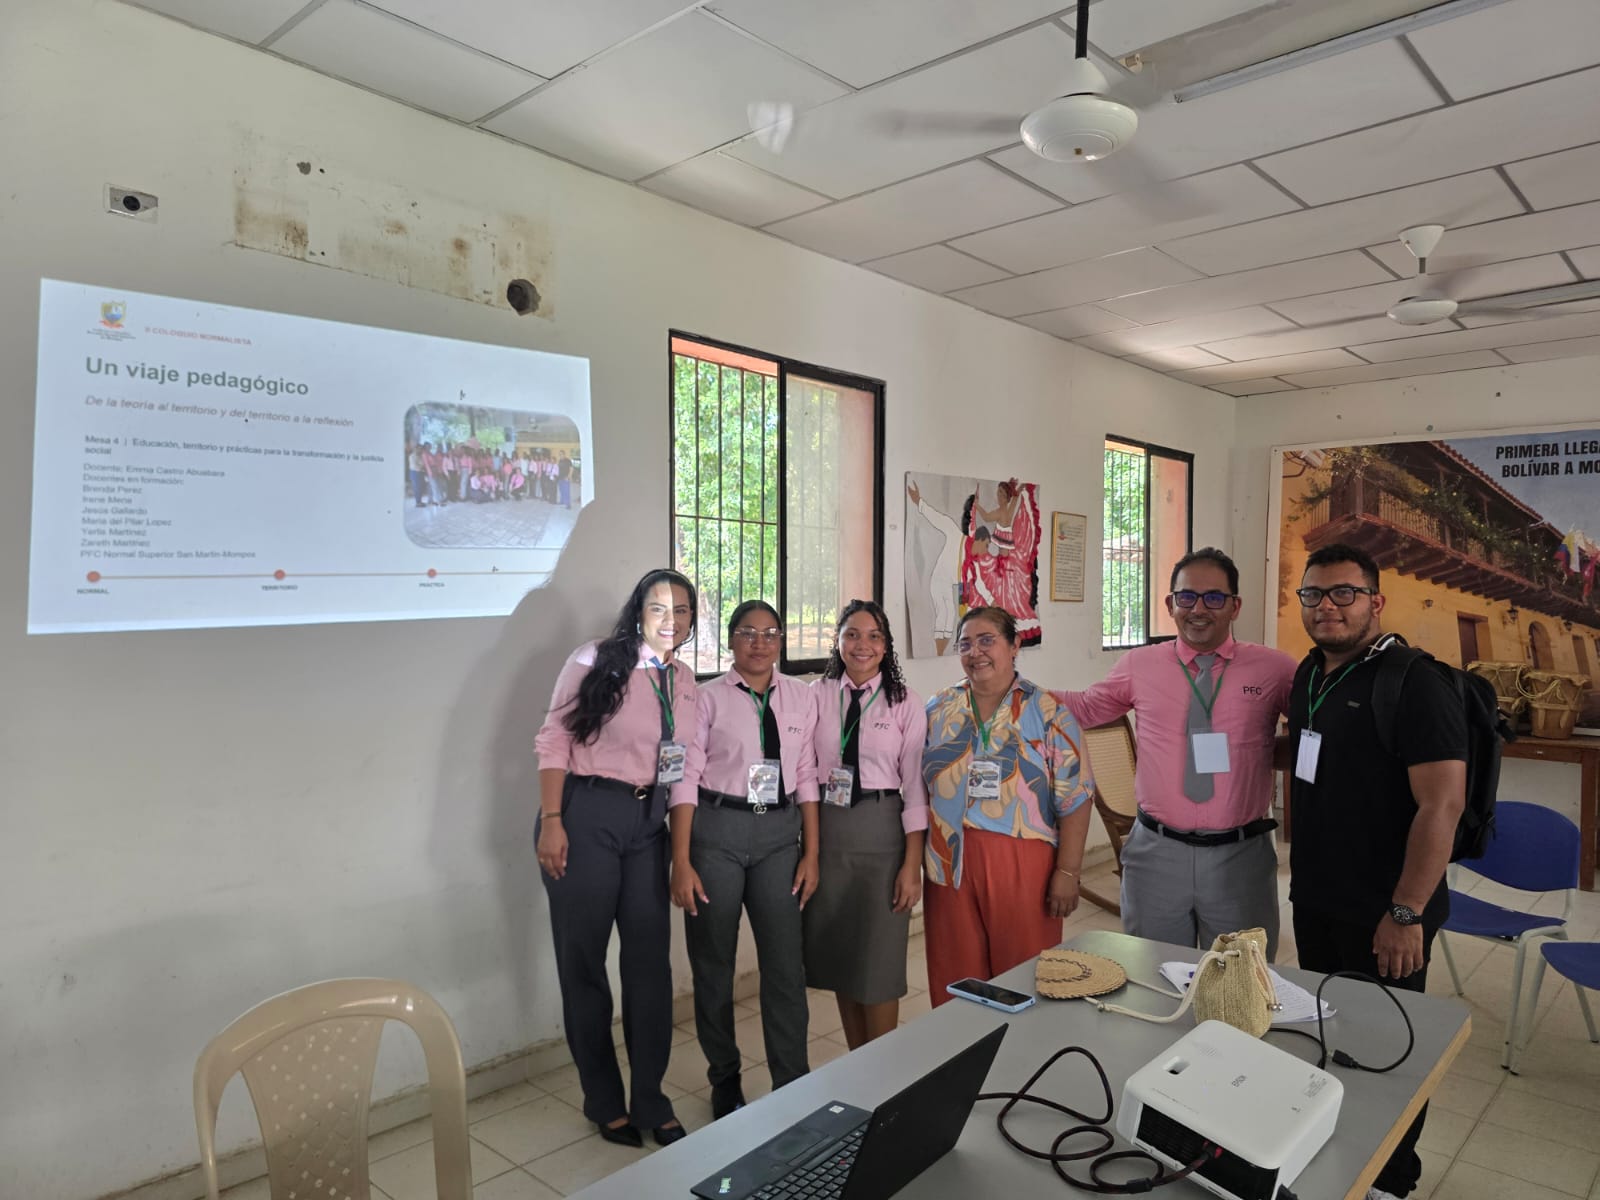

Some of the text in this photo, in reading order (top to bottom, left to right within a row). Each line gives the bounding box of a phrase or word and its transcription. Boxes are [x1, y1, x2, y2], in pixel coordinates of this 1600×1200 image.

[152, 327, 198, 339] COLOQUIO
[199, 333, 252, 346] NORMALISTA
[85, 356, 309, 396] Un viaje pedagógico
[85, 395, 103, 406] De
[106, 396, 117, 407] la
[158, 402, 169, 411] al
[171, 403, 218, 416] territorio
[220, 408, 227, 418] y
[229, 408, 247, 418] del
[249, 410, 290, 423] territorio
[293, 415, 300, 423] a
[302, 415, 311, 424] la
[85, 435, 111, 445] Mesa
[113, 437, 119, 445] 4
[183, 442, 217, 452] territorio
[85, 446, 112, 455] social
[1496, 440, 1600, 459] PRIMERA LLEG
[1502, 460, 1559, 478] BOLÍVAR
[1564, 461, 1574, 475] A
[109, 517, 123, 525] del
[103, 550, 136, 558] Normal
[176, 551, 193, 559] San
[1243, 686, 1263, 696] PFC
